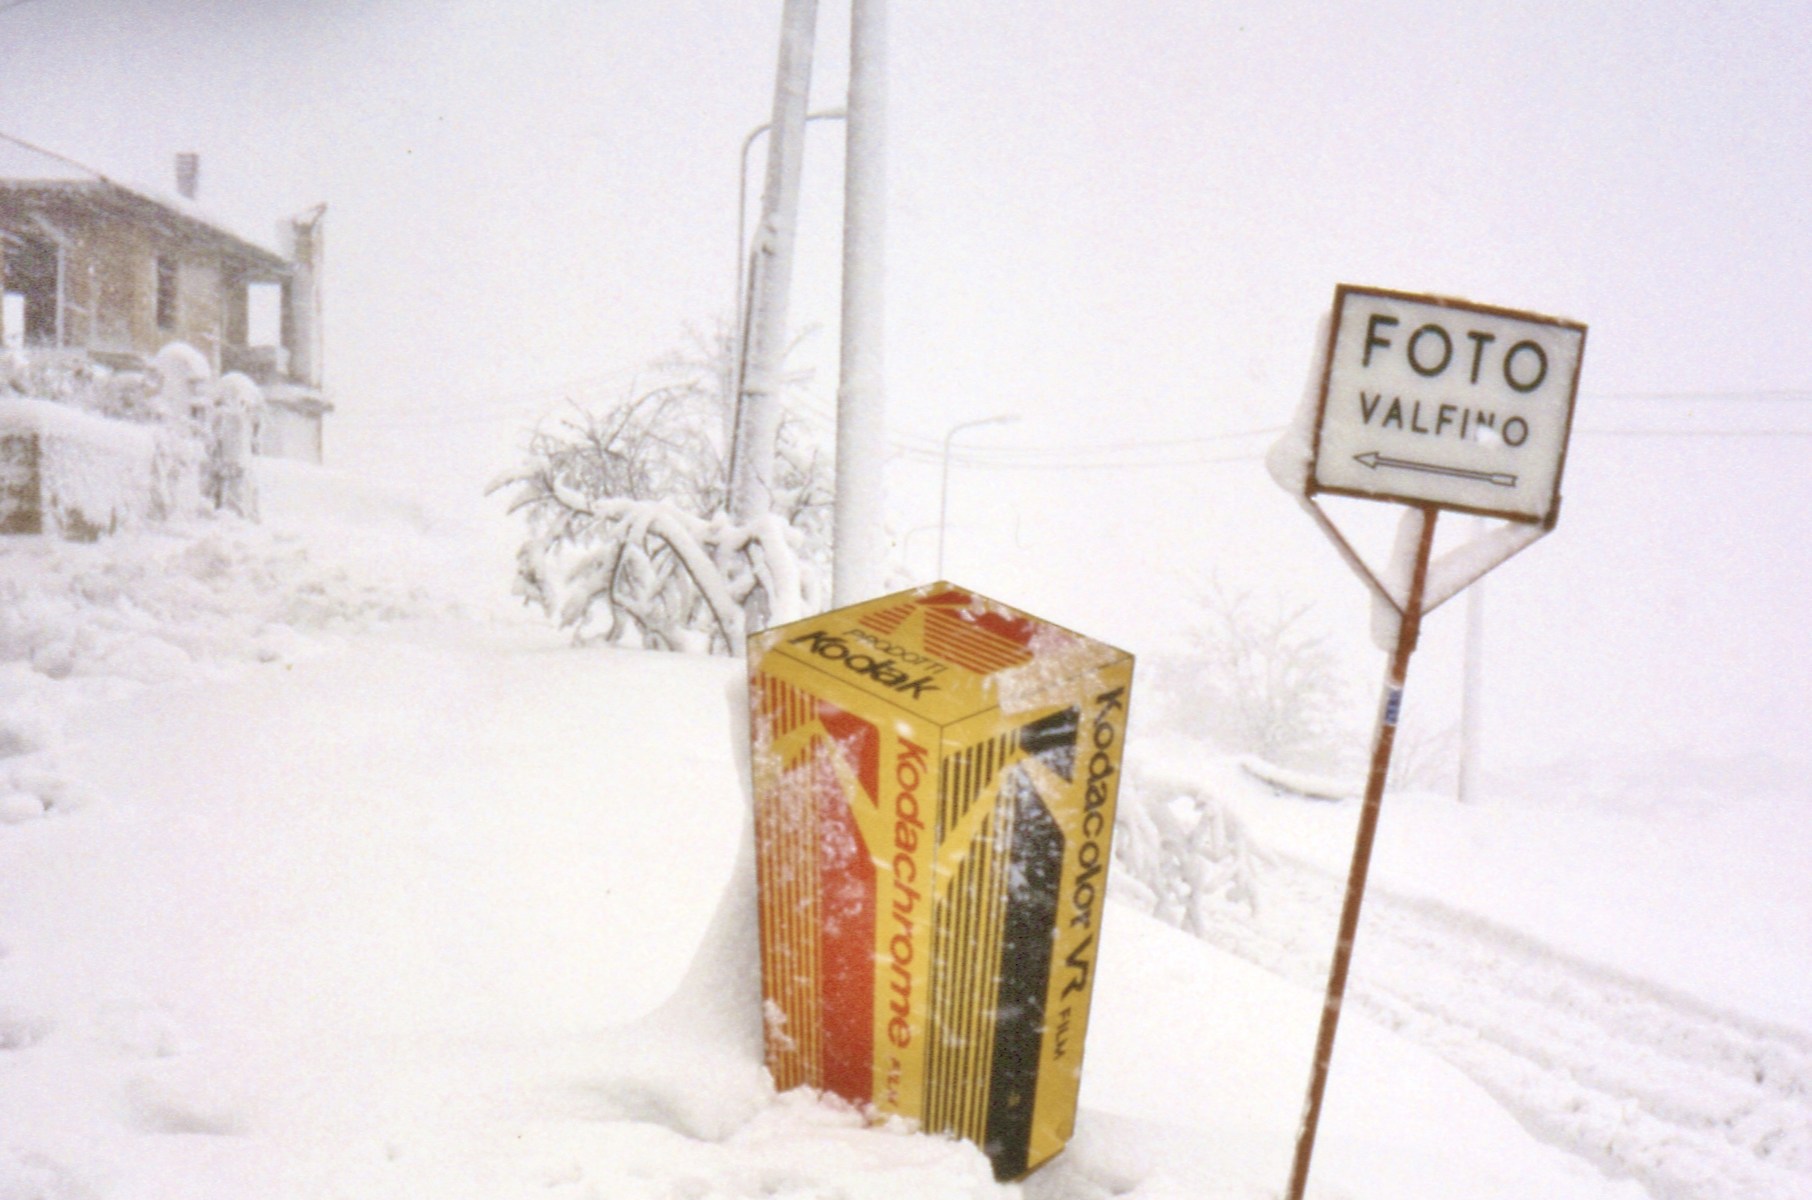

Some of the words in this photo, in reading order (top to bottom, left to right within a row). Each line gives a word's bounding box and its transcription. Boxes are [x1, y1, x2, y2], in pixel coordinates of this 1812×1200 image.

[1361, 313, 1548, 393] FOTO
[787, 630, 941, 701] Kodak
[1069, 686, 1126, 930] Kodacolor
[887, 737, 929, 1050] Kodachrome
[1060, 933, 1094, 1001] VR
[1053, 1005, 1072, 1061] FILM
